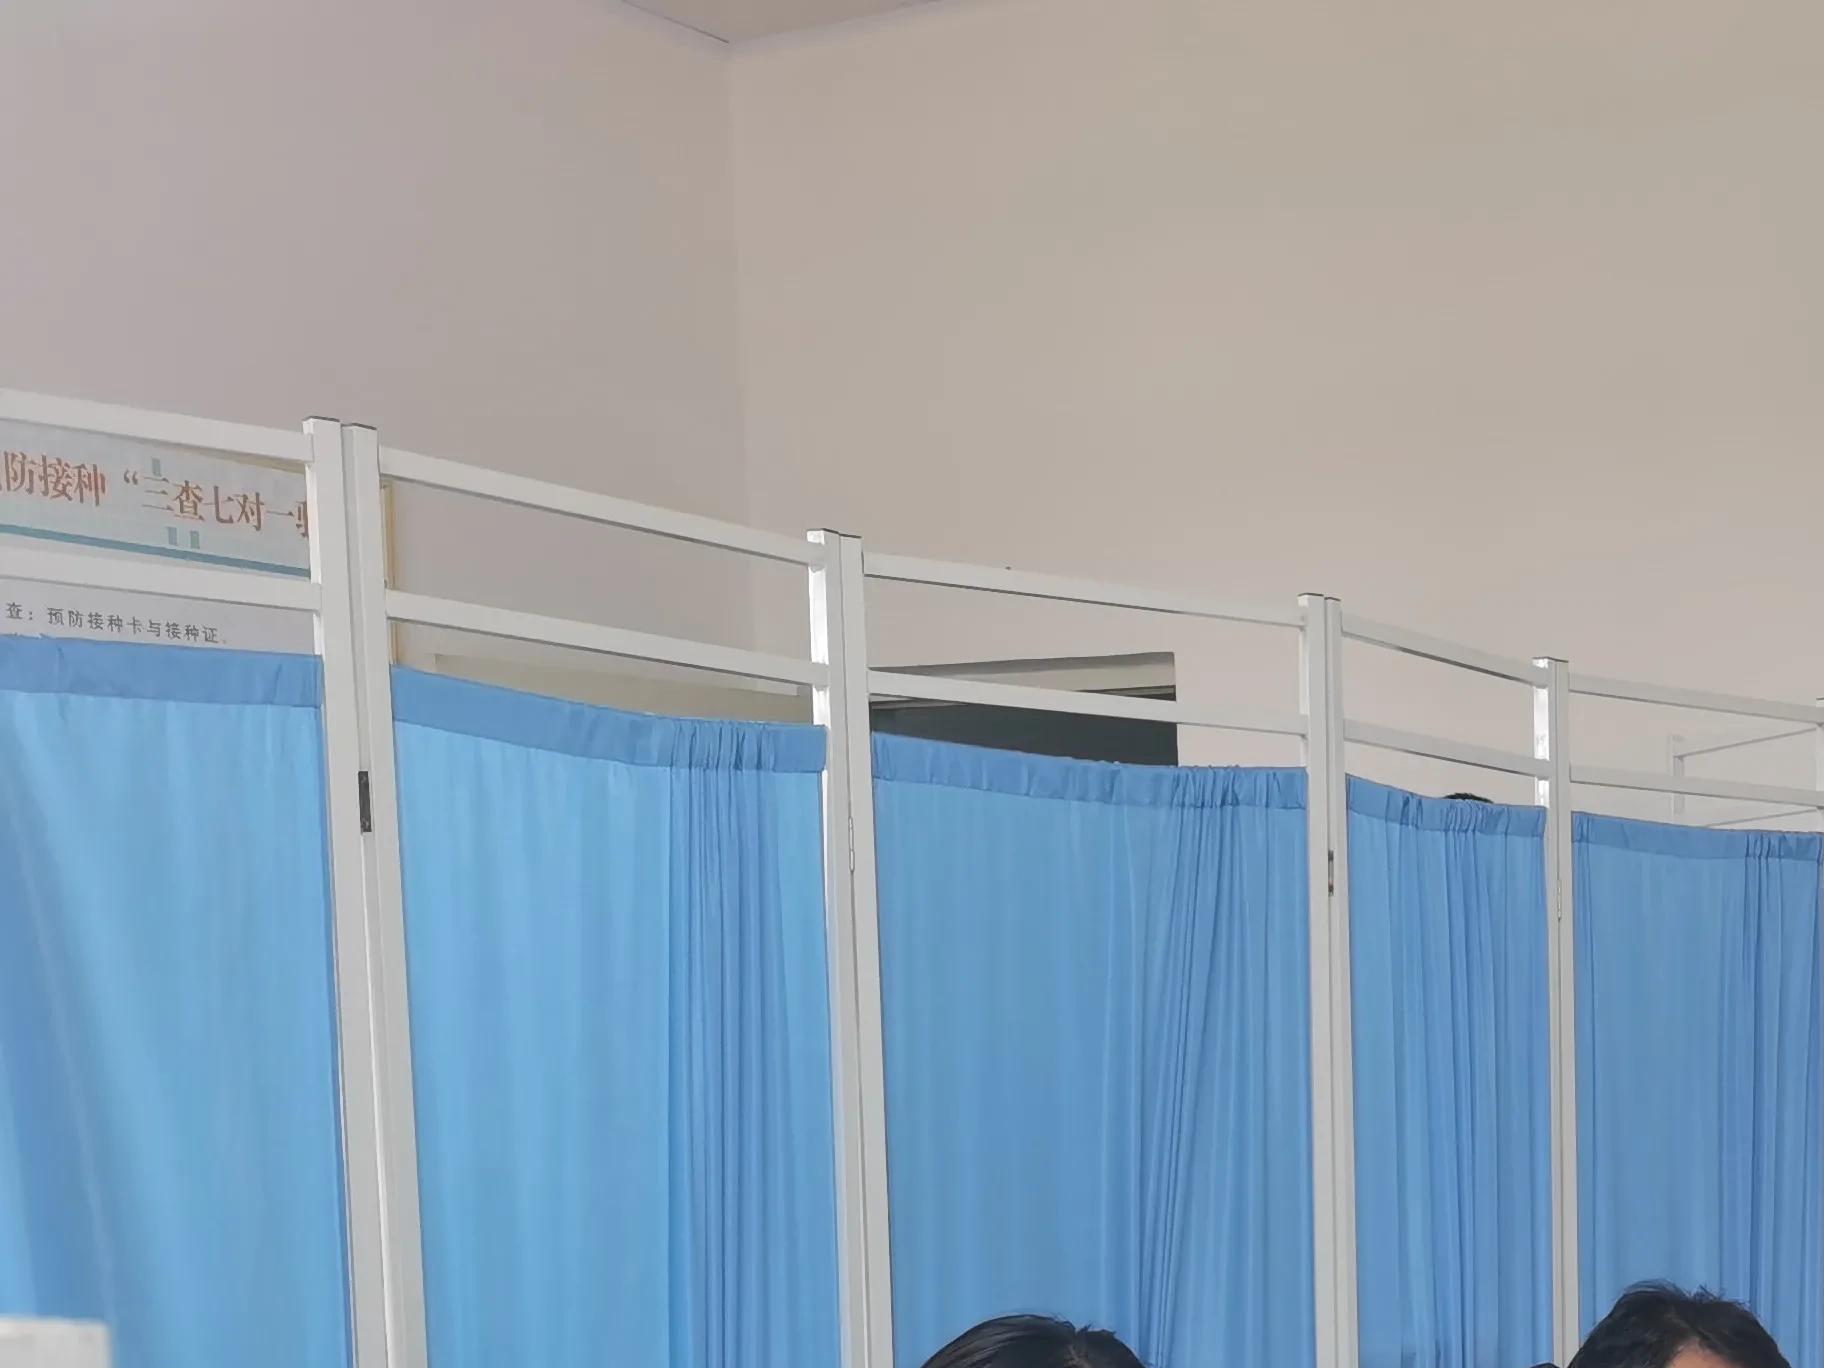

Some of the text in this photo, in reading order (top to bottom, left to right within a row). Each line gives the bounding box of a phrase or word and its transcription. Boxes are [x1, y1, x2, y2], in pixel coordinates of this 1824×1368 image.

[0, 450, 310, 538] 防接种“三查七对一
